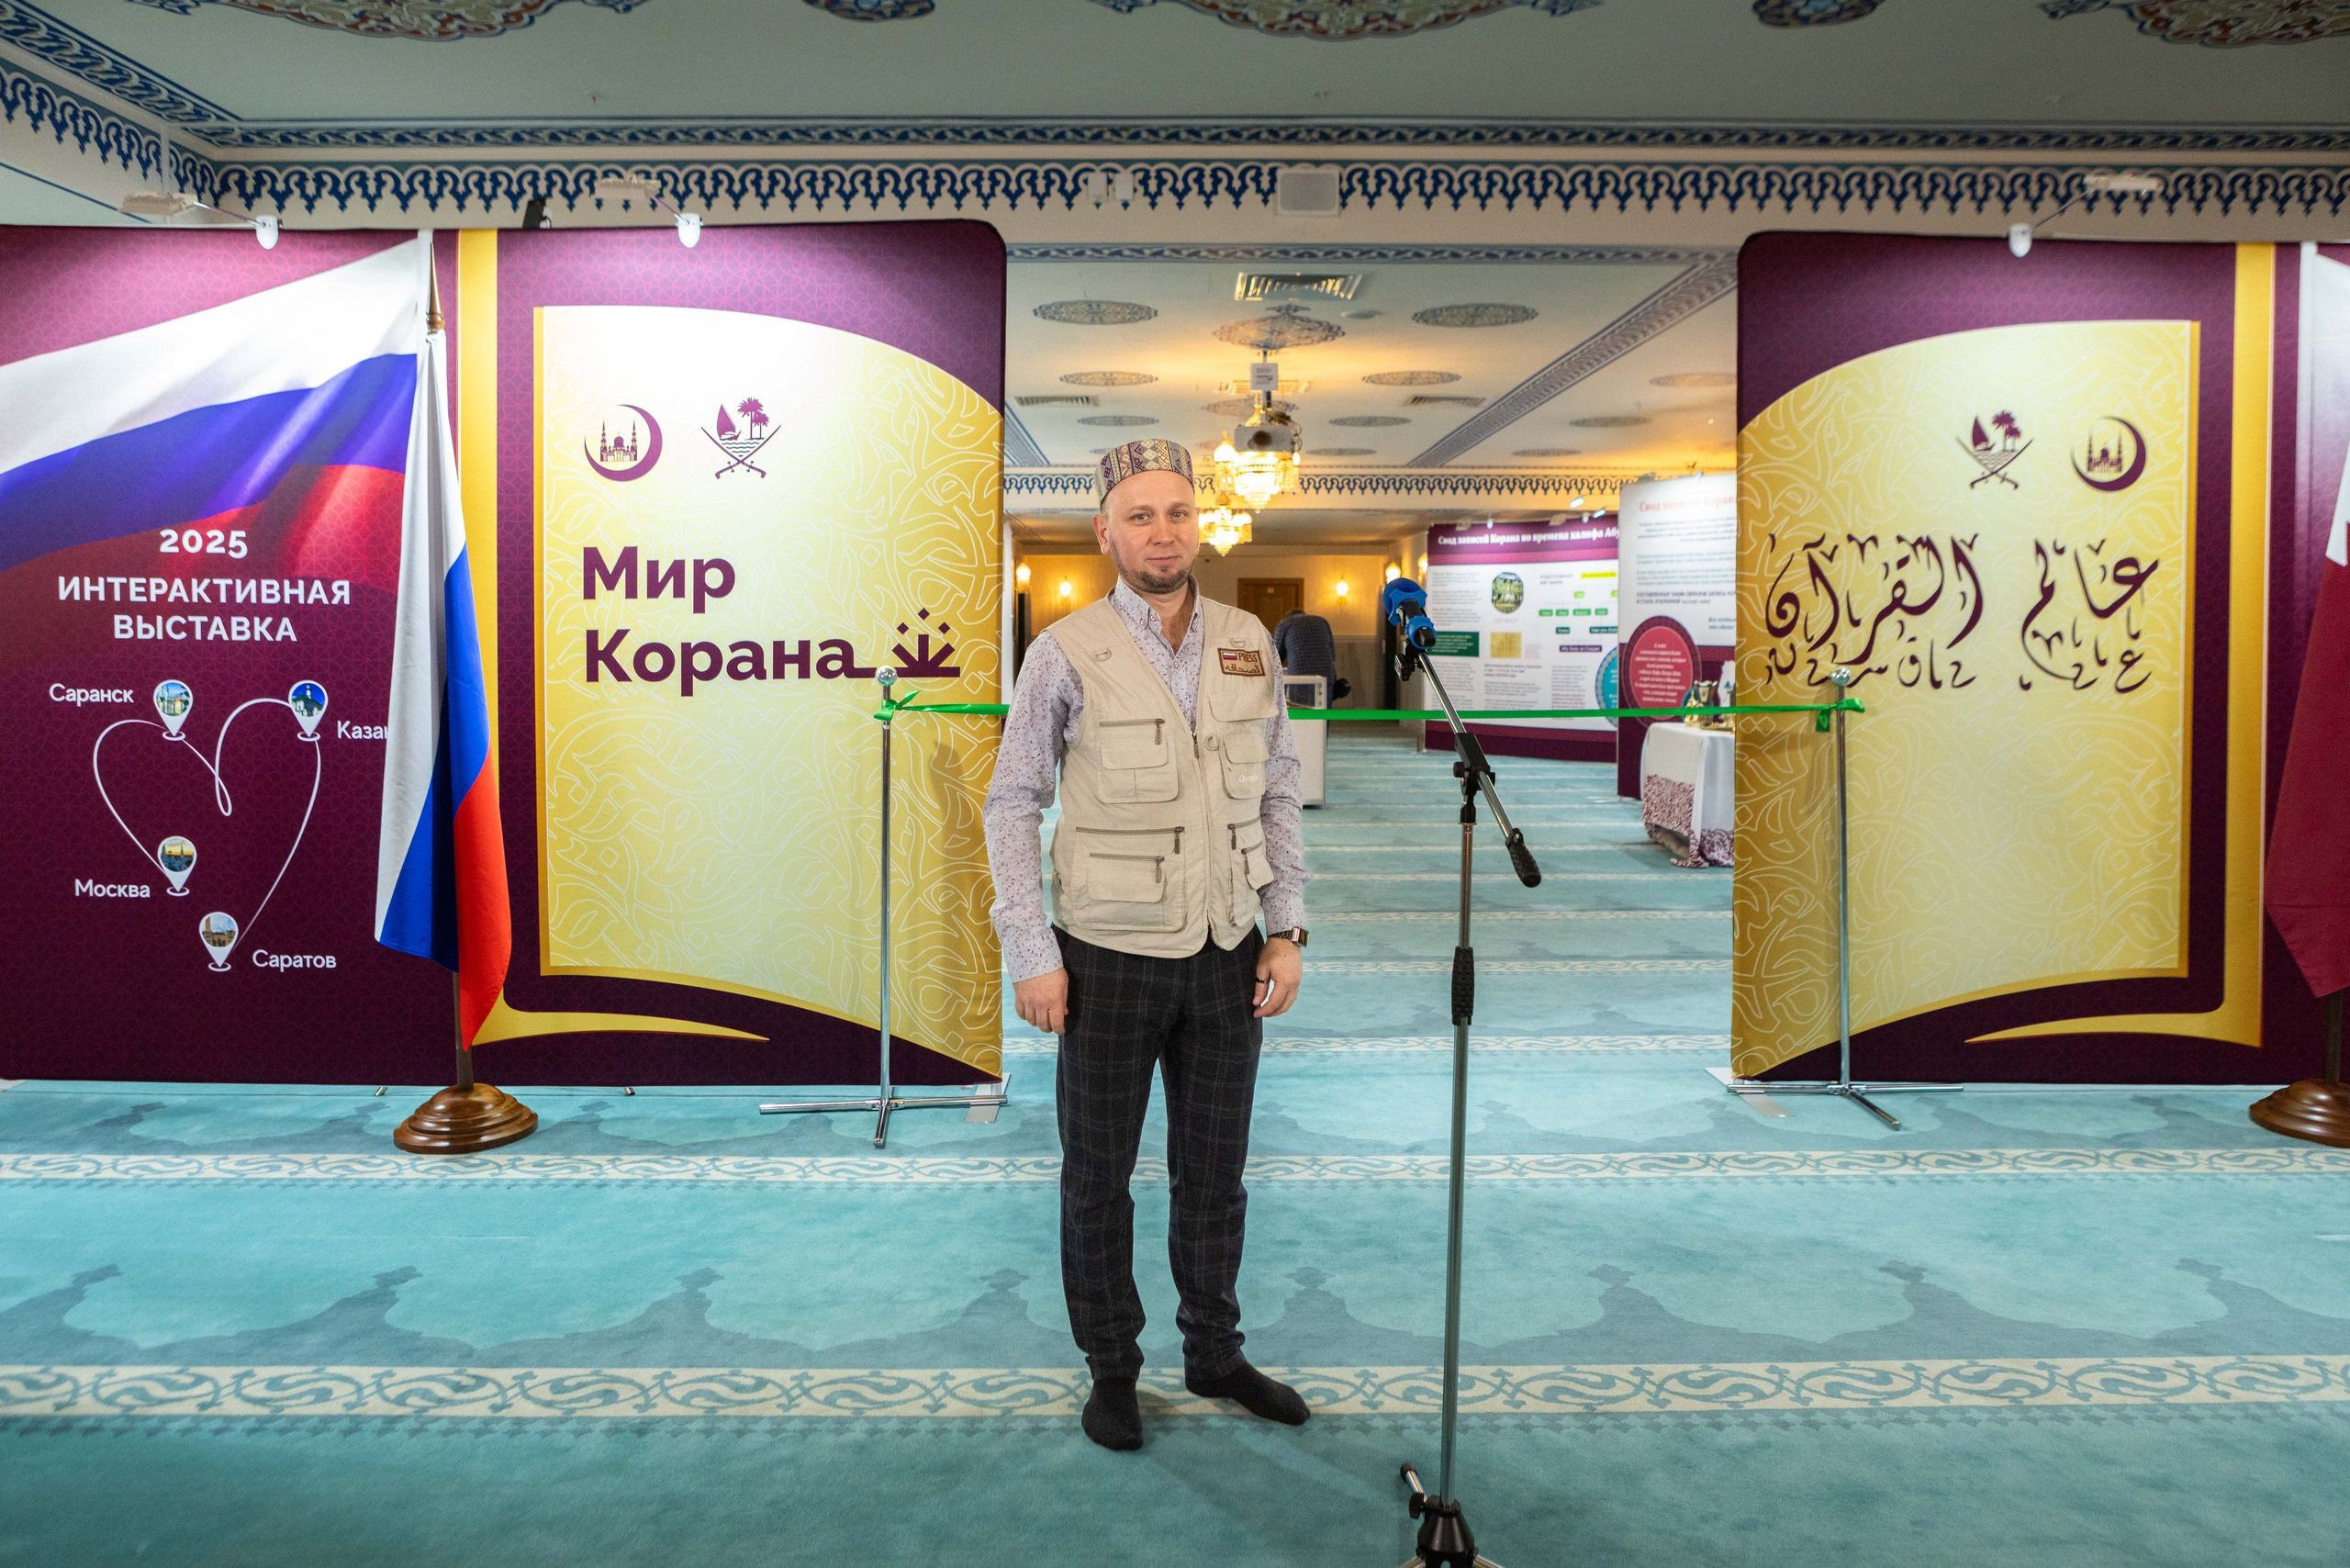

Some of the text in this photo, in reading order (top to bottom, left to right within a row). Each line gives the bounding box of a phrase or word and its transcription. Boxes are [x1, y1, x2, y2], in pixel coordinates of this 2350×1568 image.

[160, 529, 248, 559] 2025
[1438, 534, 1457, 546] Свод
[1458, 532, 1489, 545] записей
[1490, 532, 1520, 546] Корана
[1521, 533, 1532, 543] во
[1533, 531, 1569, 544] времена
[1570, 528, 1603, 541] халифа
[58, 576, 351, 605] ИНТЕРАКТИВНАЯ
[583, 546, 735, 614] Мир
[114, 615, 297, 642] ВЫСТАВКА
[586, 629, 877, 697] Корана
[1238, 653, 1258, 662] PRESS
[49, 683, 134, 705] Саранск
[75, 879, 151, 899] Москва
[252, 949, 337, 971] Саратов
